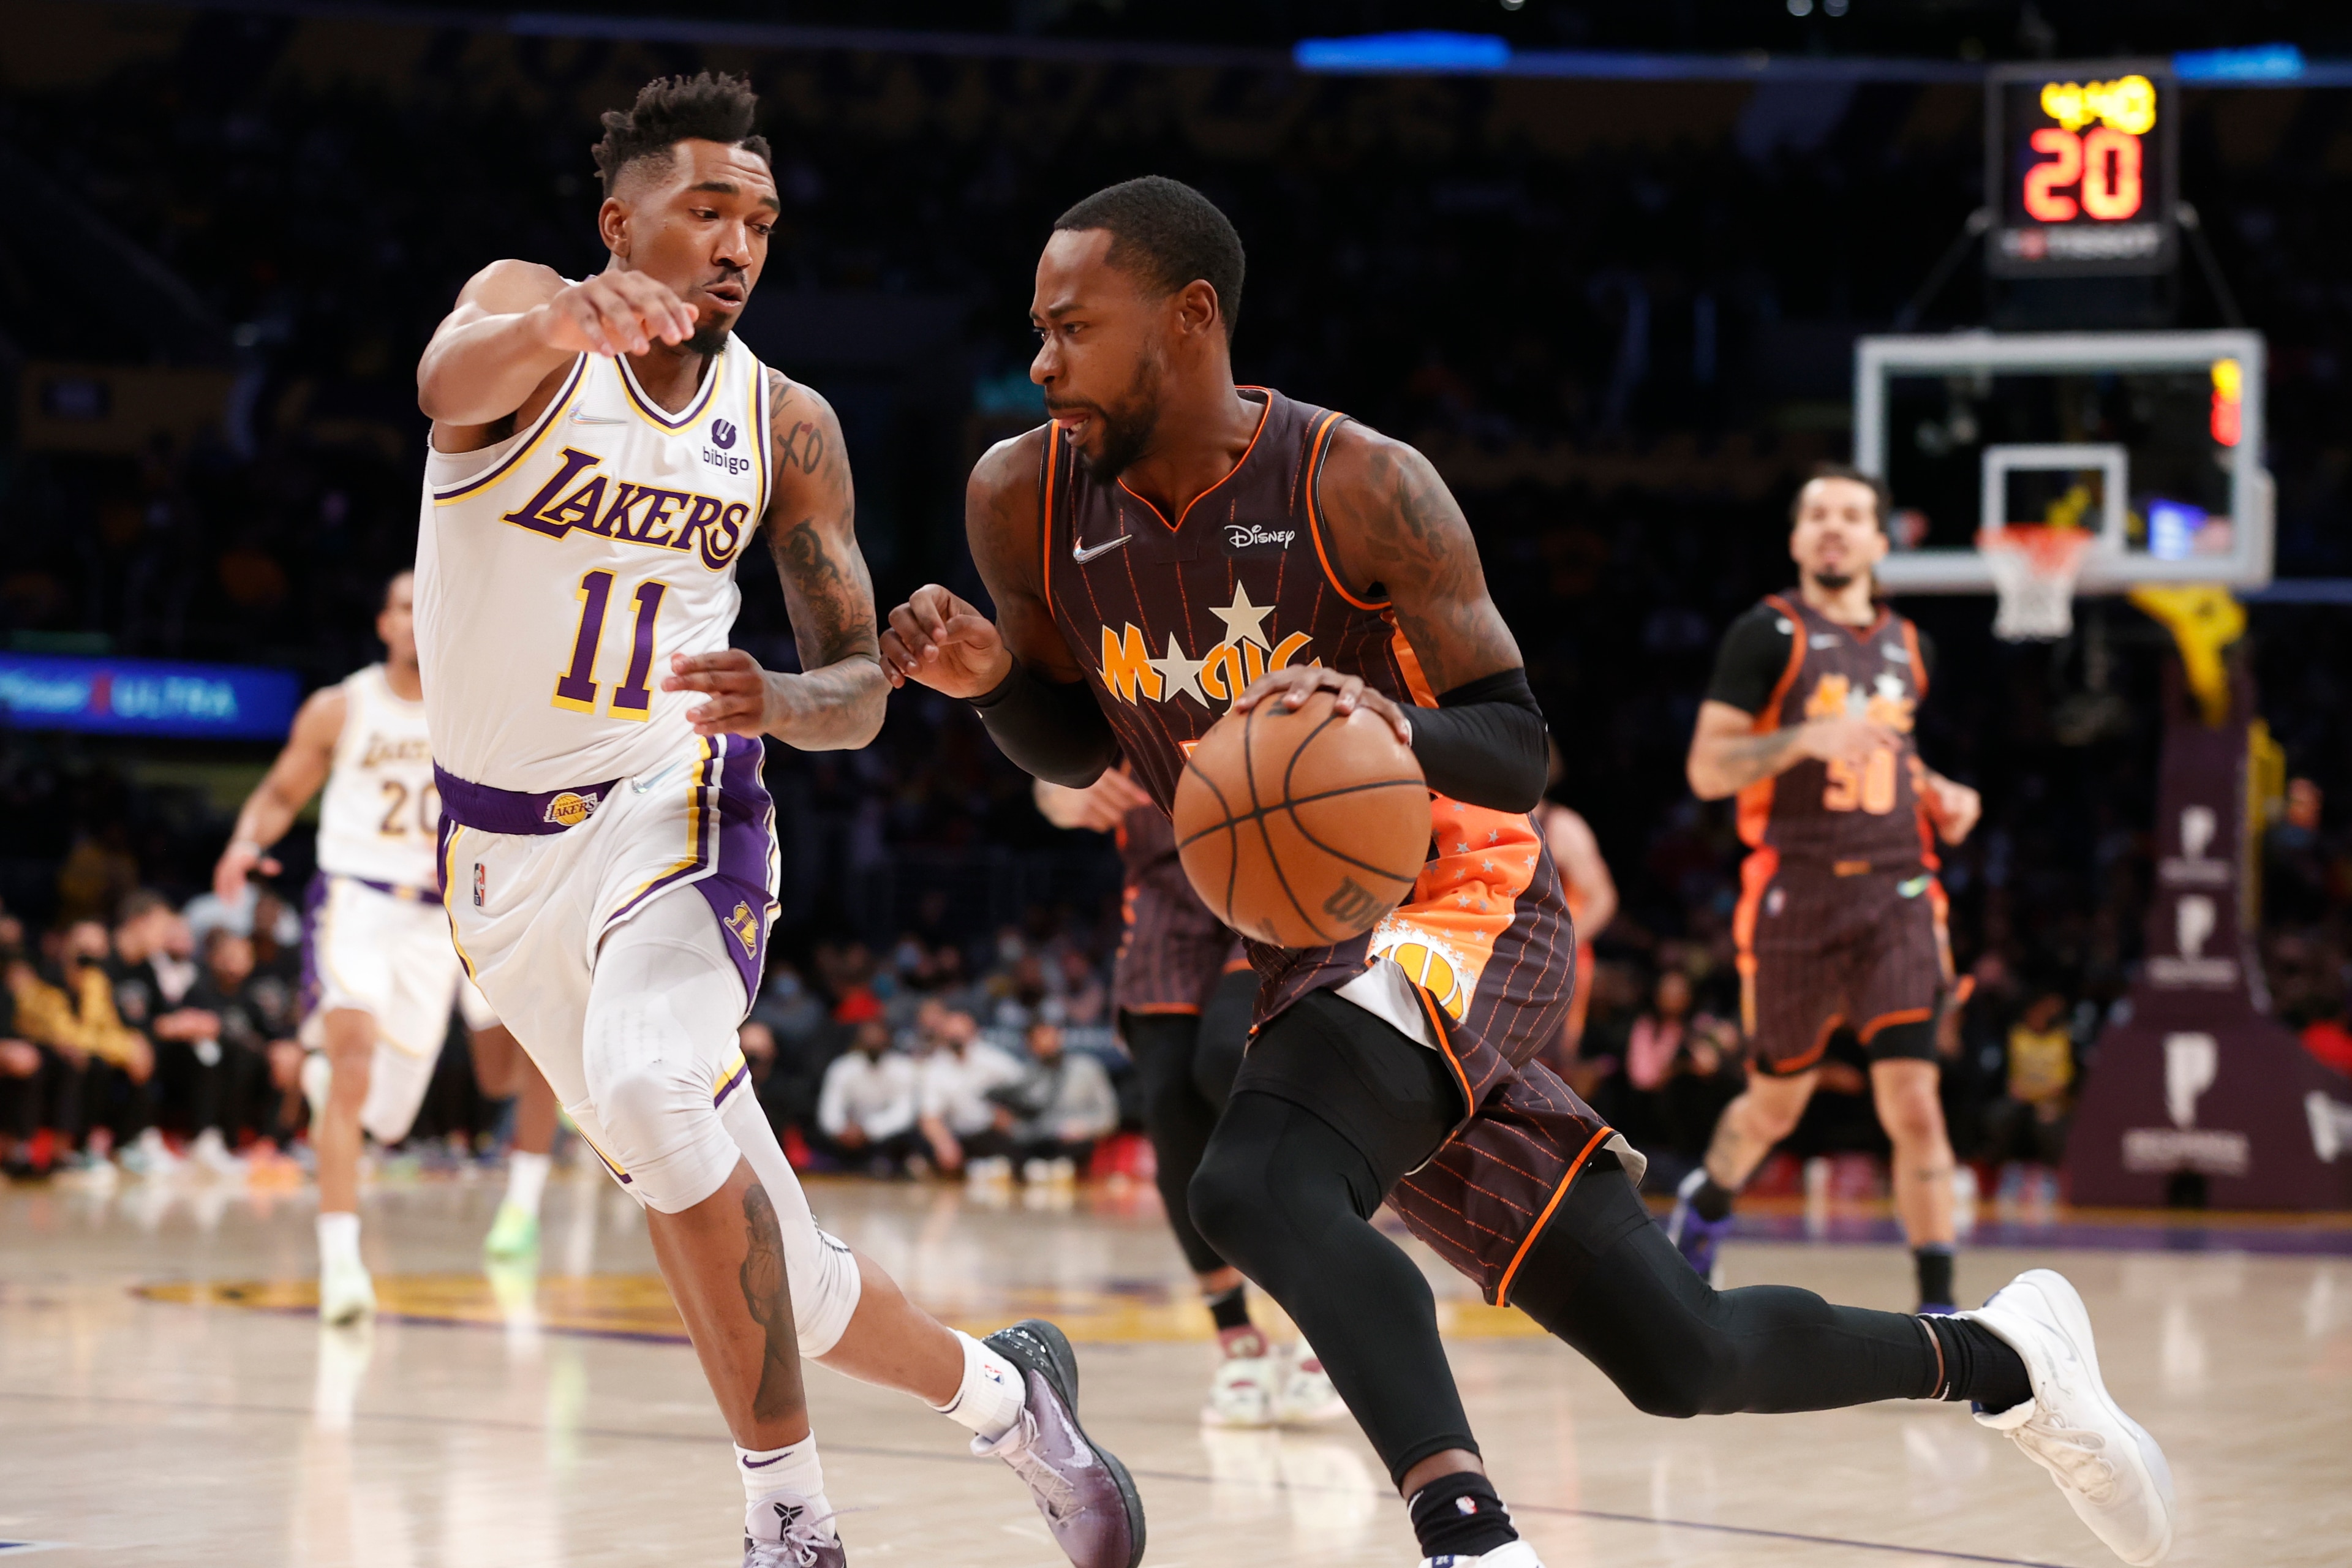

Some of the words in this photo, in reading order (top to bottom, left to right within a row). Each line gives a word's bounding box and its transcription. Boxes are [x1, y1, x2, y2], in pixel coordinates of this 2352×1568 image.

[2024, 127, 2143, 222] 20
[703, 446, 749, 475] bibigo
[499, 445, 751, 572] LAKERS
[1224, 524, 1295, 549] Disney
[551, 567, 669, 722] 11
[379, 779, 440, 836] 20
